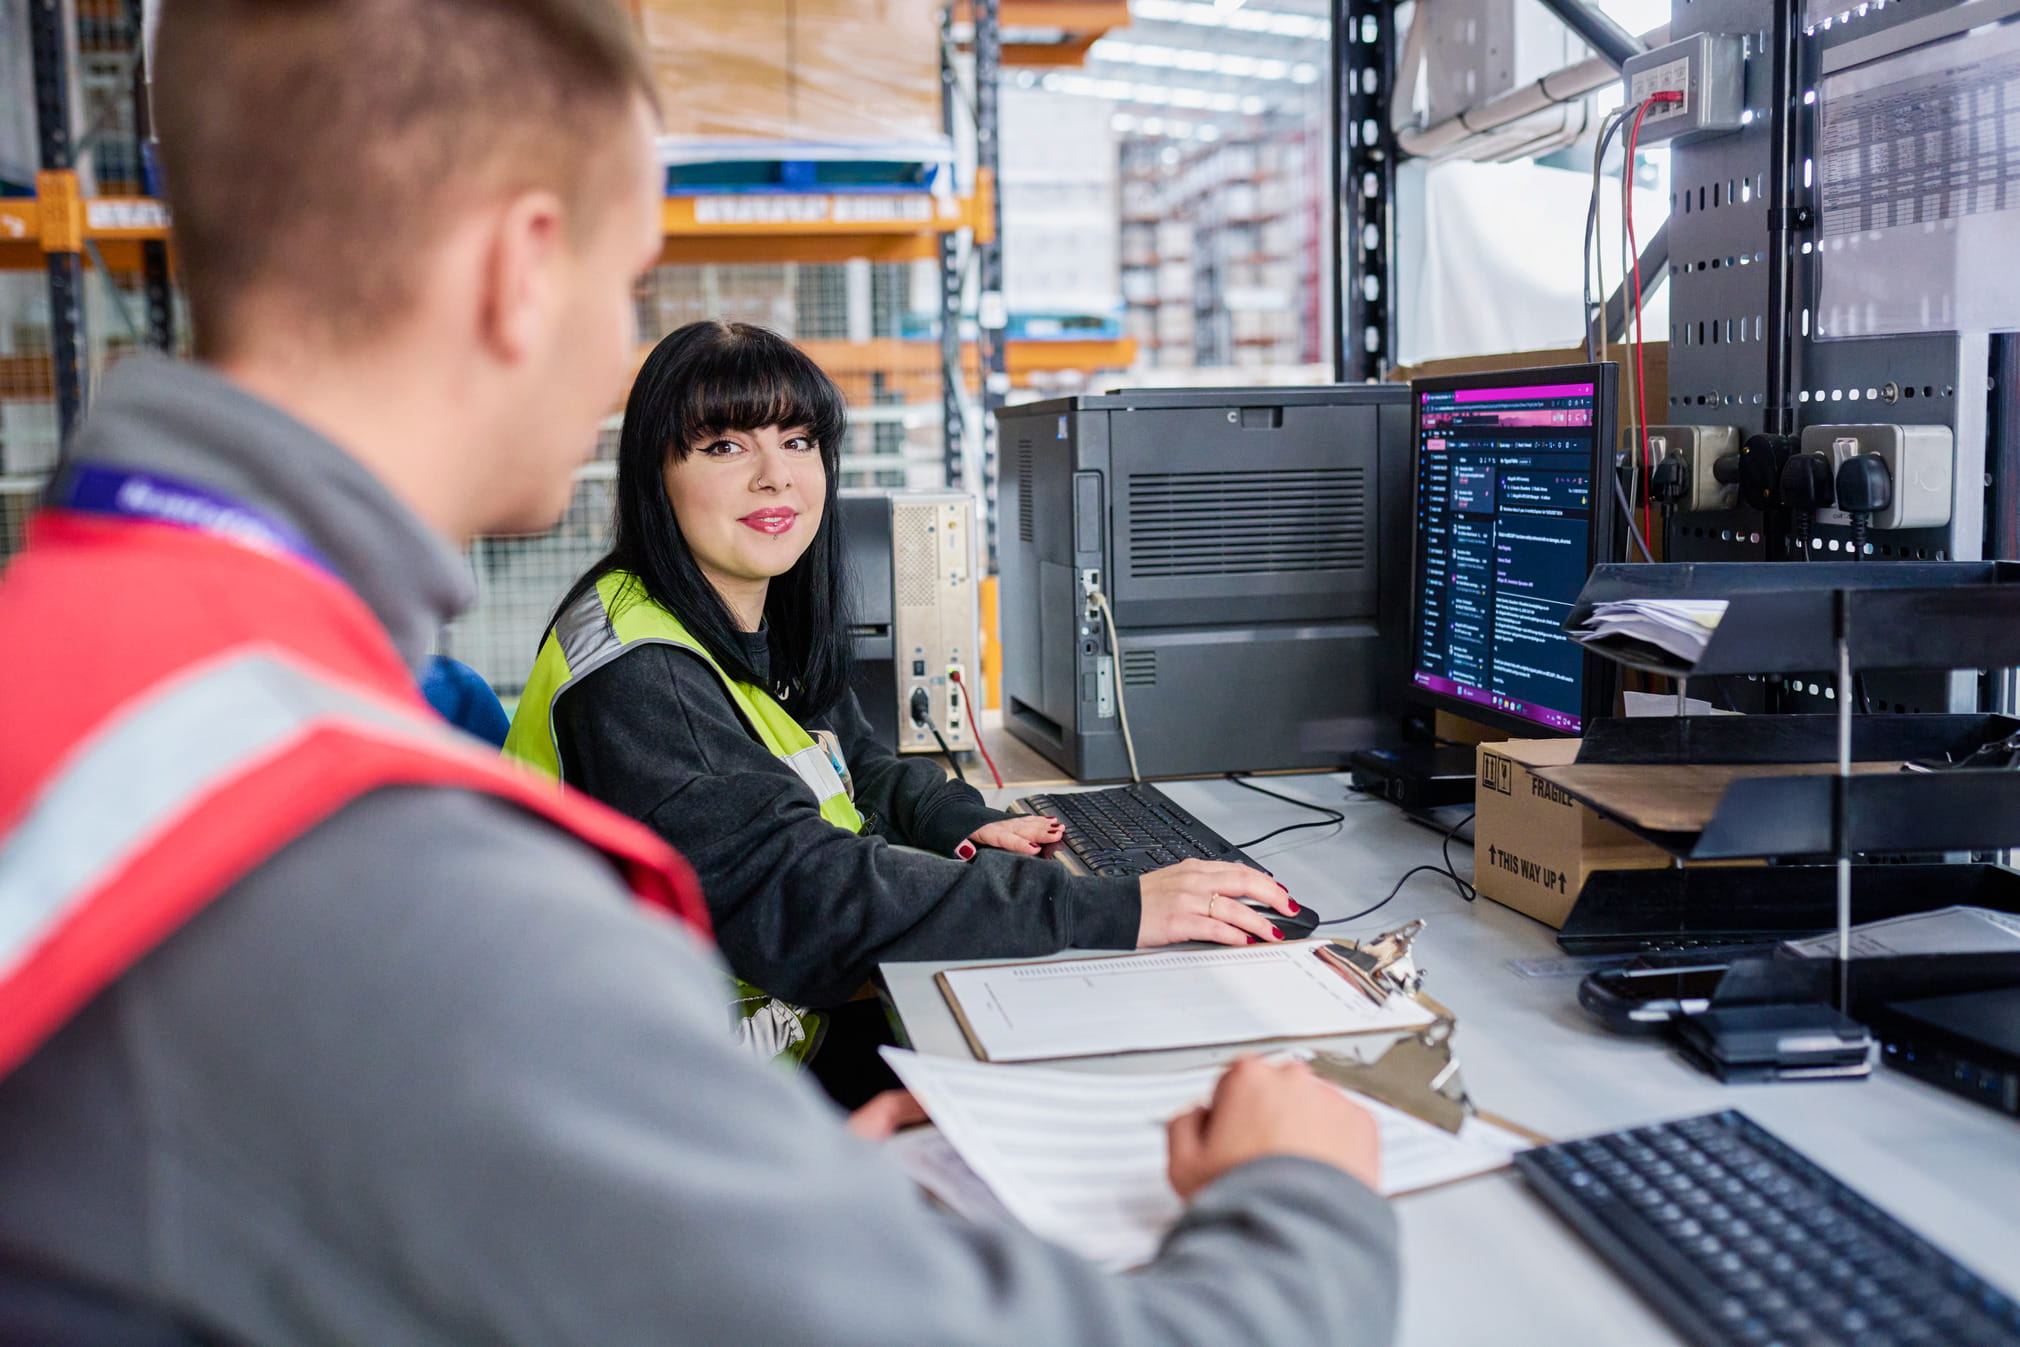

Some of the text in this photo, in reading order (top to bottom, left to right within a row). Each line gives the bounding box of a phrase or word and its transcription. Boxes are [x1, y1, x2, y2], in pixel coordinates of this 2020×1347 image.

[1497, 849, 1557, 890] THIS WAY UP
